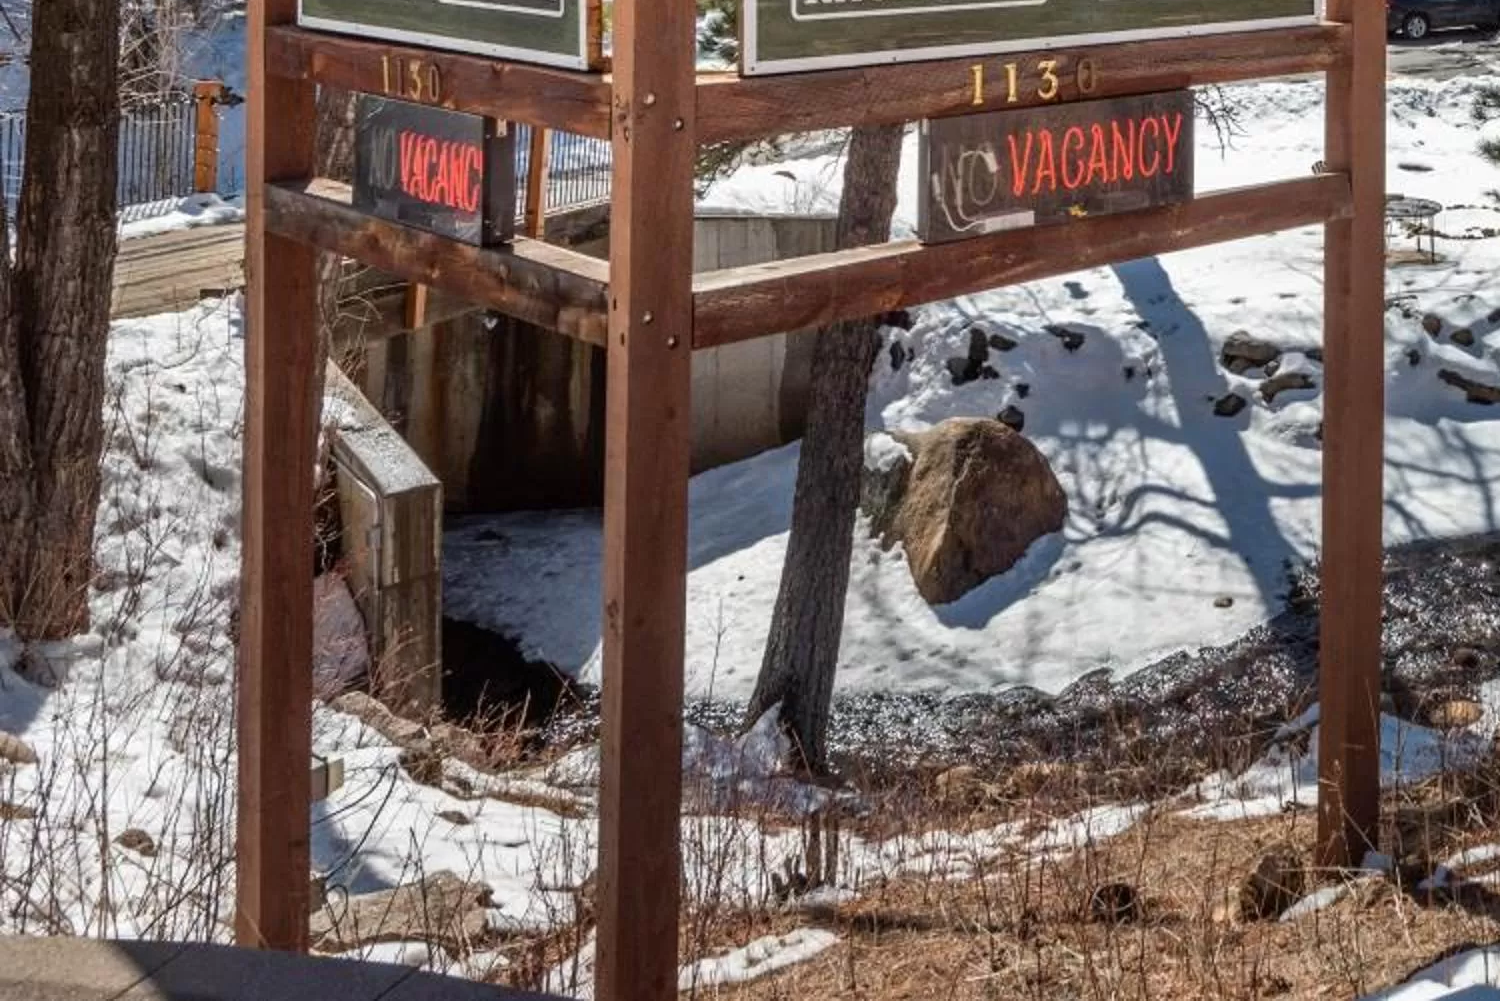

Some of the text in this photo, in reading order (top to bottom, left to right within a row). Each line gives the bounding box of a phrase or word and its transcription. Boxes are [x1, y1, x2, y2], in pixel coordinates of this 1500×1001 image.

[382, 55, 440, 102] 1130
[970, 58, 1096, 104] 1130
[400, 130, 484, 213] VACANC
[1008, 112, 1183, 197] VACANCY
